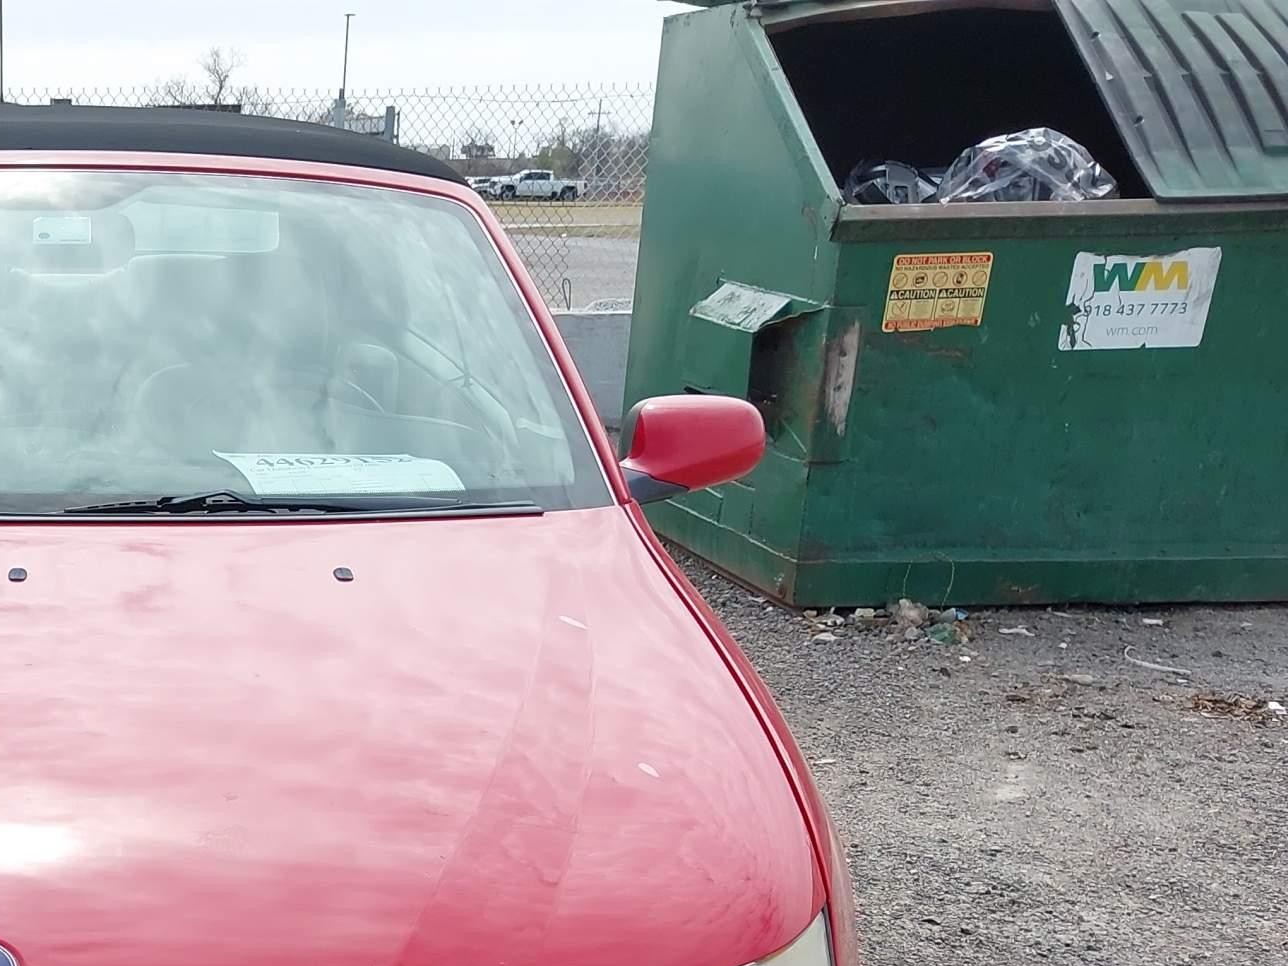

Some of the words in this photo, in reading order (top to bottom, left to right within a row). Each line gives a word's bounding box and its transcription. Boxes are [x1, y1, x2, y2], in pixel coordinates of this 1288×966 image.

[899, 257, 911, 265] DO
[912, 257, 927, 265] NOT
[928, 256, 948, 264] PARK
[949, 256, 961, 264] OR
[962, 255, 988, 264] BLOCK
[1093, 261, 1189, 292] WM
[898, 290, 936, 299] CAUTION
[947, 288, 984, 298] CAUTION
[1084, 304, 1112, 317] 918
[1116, 303, 1145, 316] 437
[1151, 302, 1188, 315] 7773
[1106, 325, 1158, 337] wm.com
